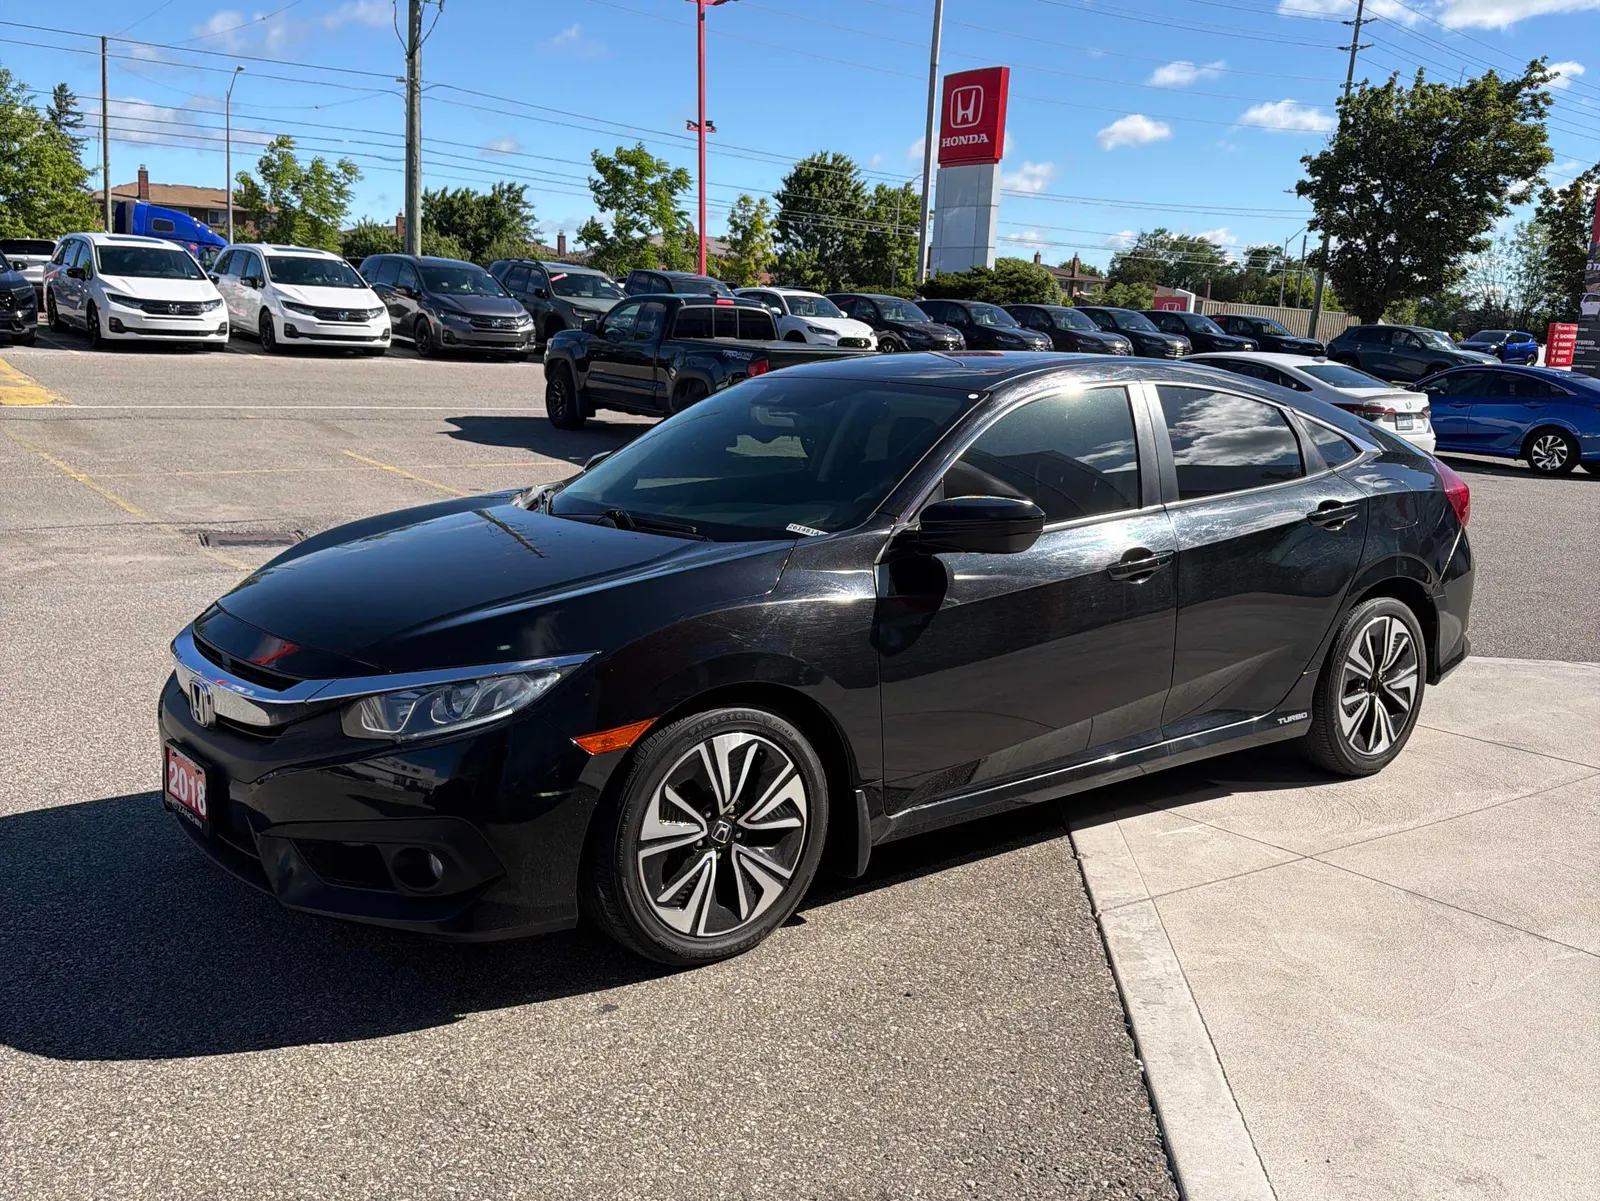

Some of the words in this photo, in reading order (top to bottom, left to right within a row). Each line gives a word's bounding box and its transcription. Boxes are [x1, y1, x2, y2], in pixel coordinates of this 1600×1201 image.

[941, 133, 989, 148] HONDA
[1277, 712, 1308, 724] TURBO
[169, 761, 206, 815] 2018
